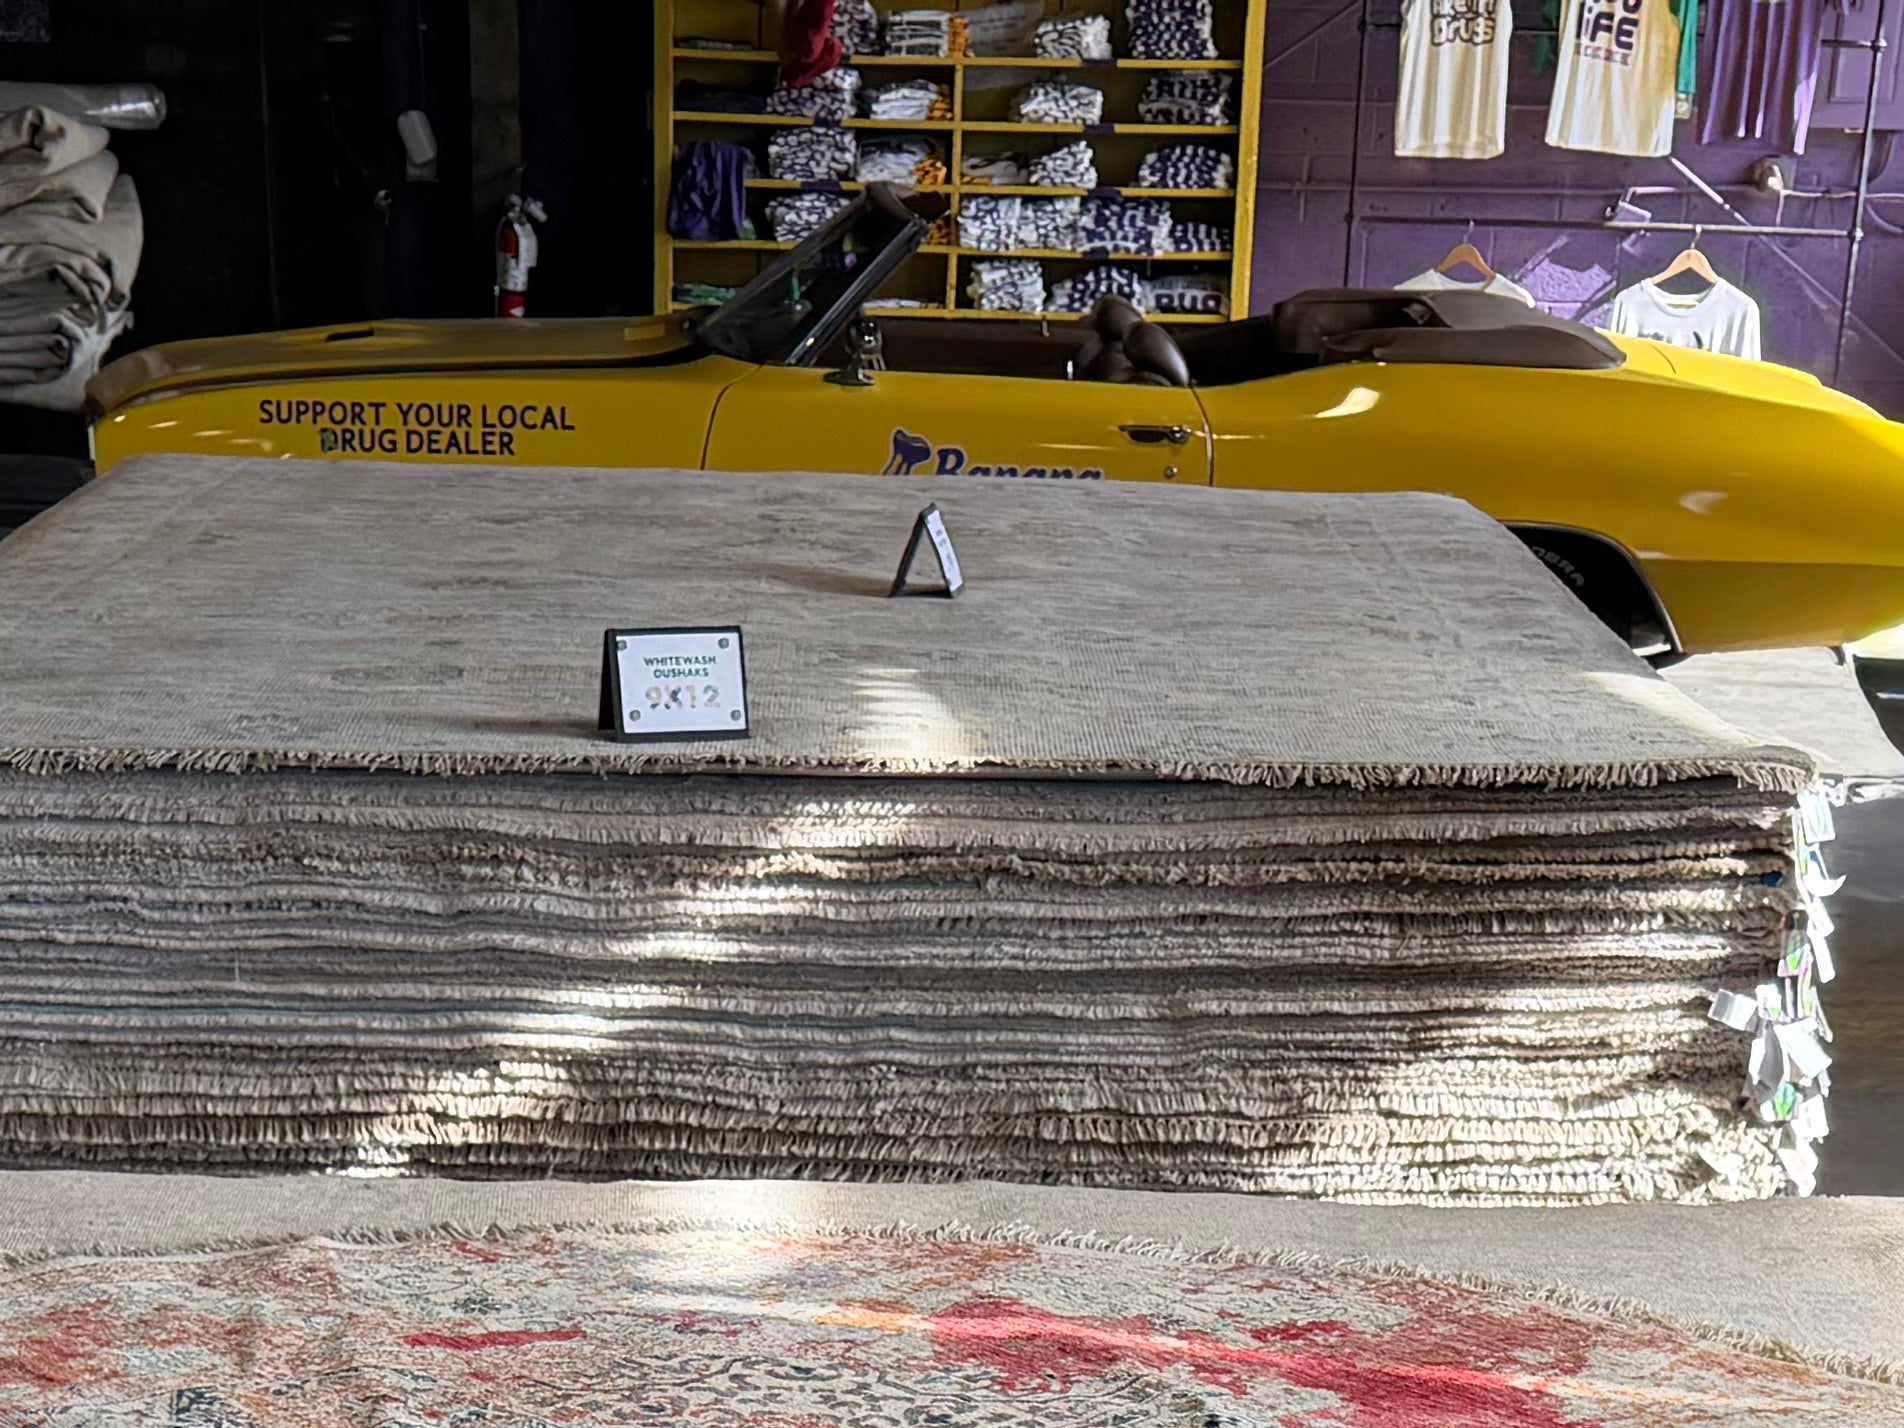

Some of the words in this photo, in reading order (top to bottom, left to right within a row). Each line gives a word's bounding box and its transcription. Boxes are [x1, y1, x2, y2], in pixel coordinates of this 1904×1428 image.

[258, 399, 387, 426] SUPPORT
[396, 402, 473, 428] YOUR
[481, 404, 576, 431] LOCAL
[405, 429, 516, 456] DEALER
[643, 655, 716, 666] WHITEWASH
[653, 667, 710, 679] OUSHAKS
